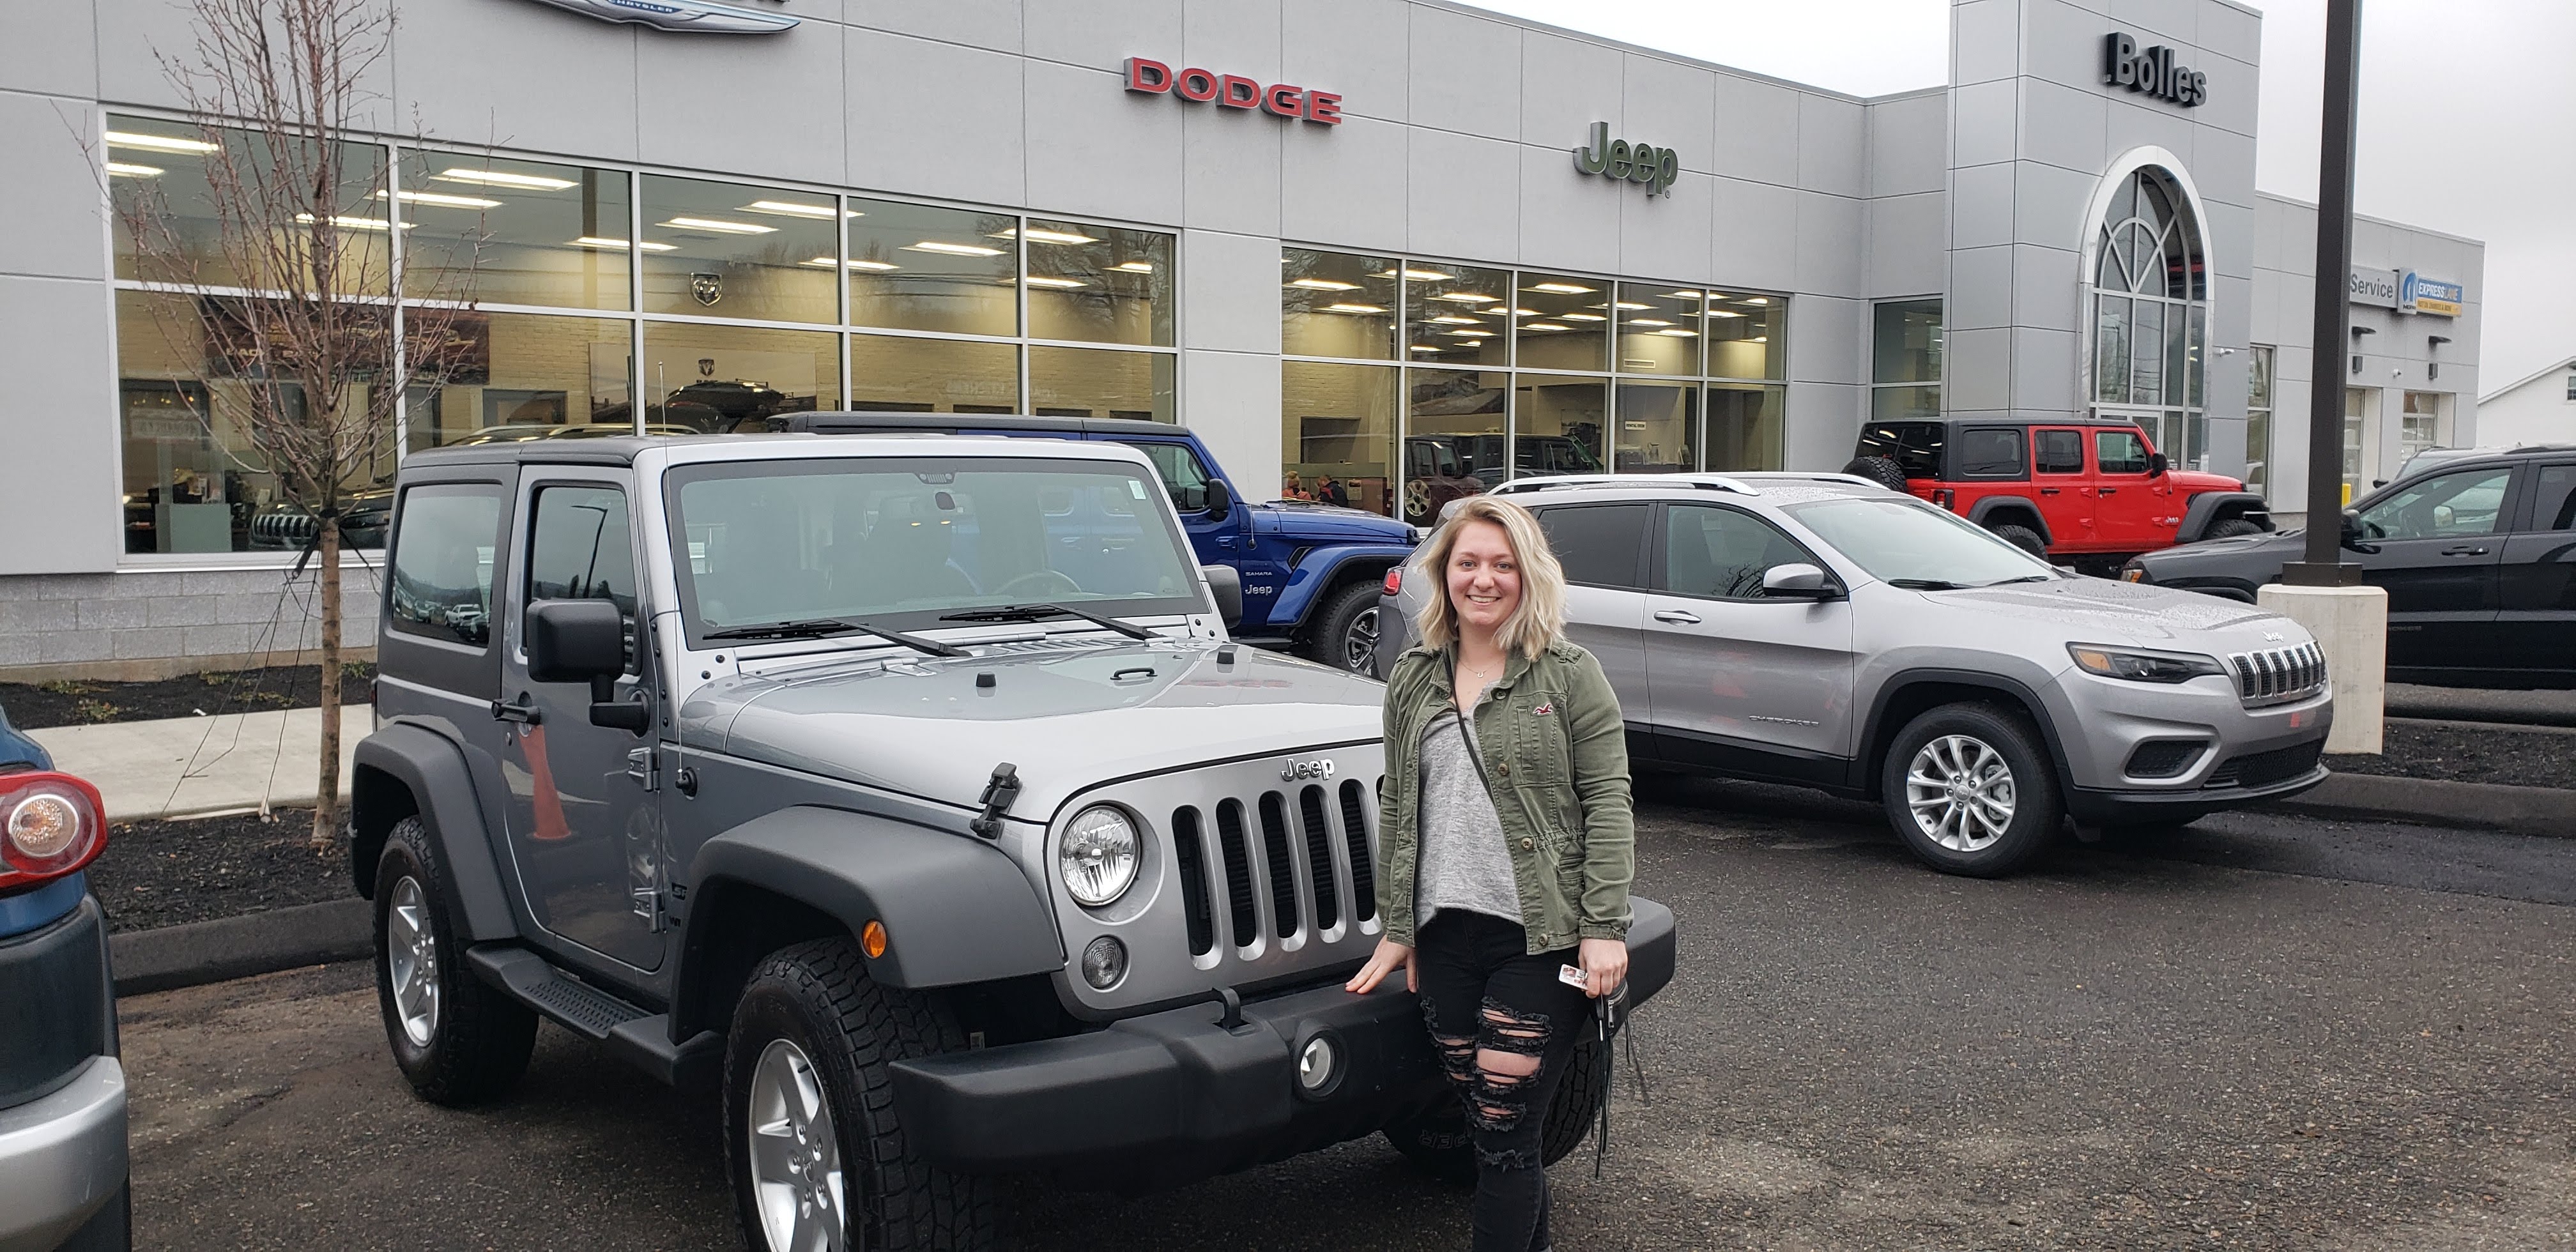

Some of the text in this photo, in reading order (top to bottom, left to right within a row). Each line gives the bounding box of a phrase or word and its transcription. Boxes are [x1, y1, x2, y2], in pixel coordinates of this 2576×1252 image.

[2108, 32, 2207, 107] Bolles
[1124, 57, 1342, 126] DODGE
[1573, 121, 1678, 196] Jeep
[2351, 273, 2393, 298] Service
[1245, 584, 1273, 596] Jeep
[2262, 631, 2284, 643] Jeep
[1281, 758, 1335, 782] Jeep
